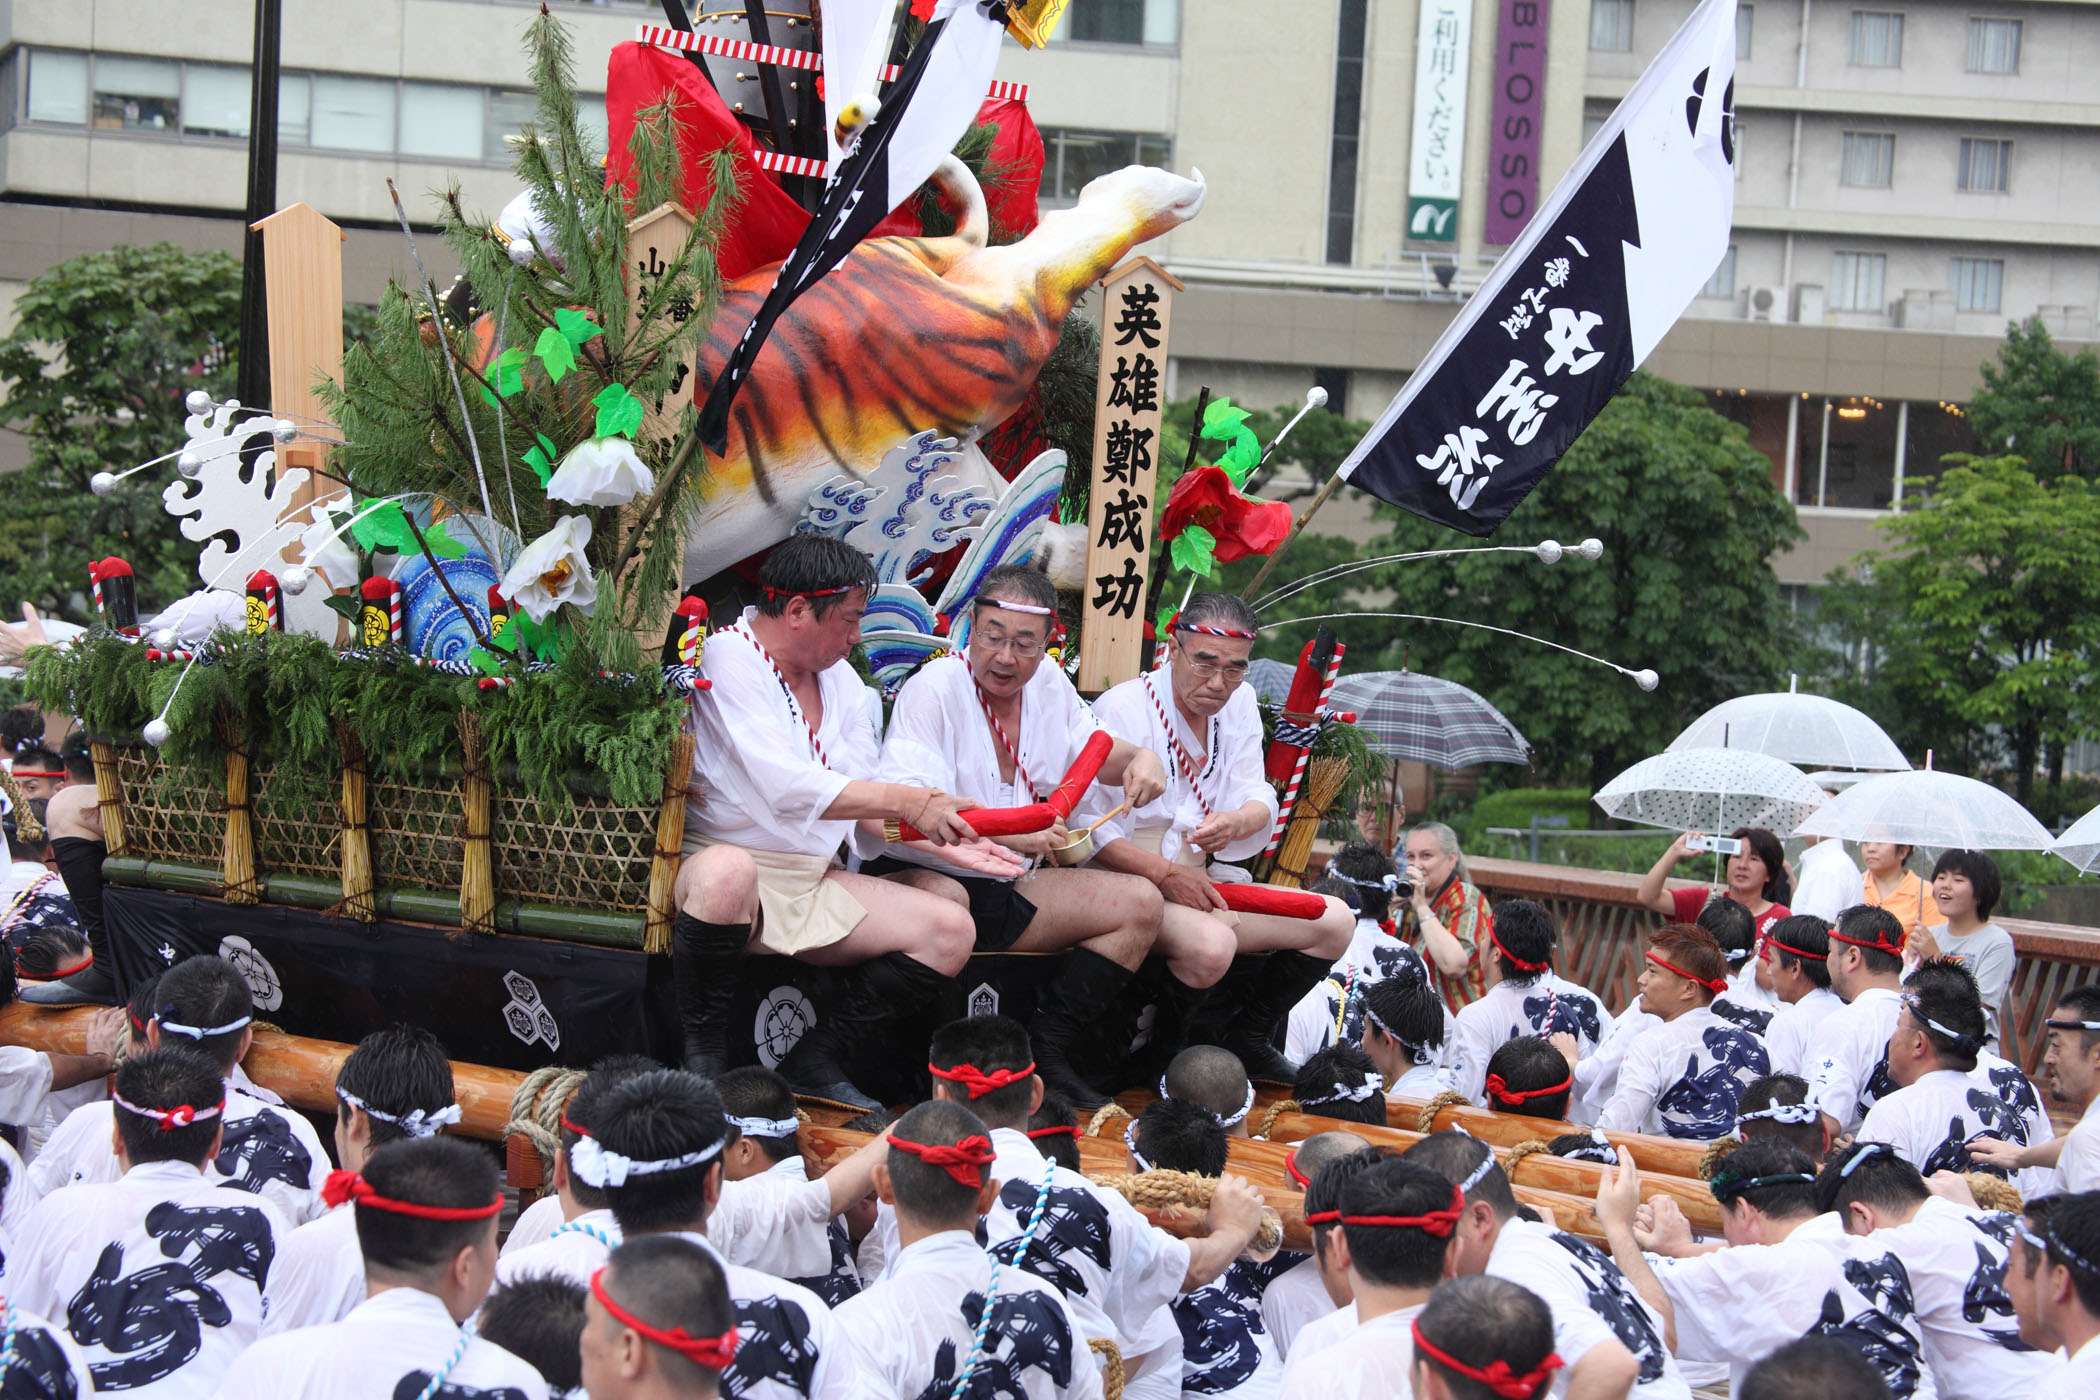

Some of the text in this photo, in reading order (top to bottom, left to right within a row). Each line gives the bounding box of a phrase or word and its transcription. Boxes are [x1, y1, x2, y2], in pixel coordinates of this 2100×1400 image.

[1499, 2, 1538, 220] BLOSSO
[1092, 283, 1162, 620] 英雄鄭成功
[1816, 1058, 1834, 1085] 中二
